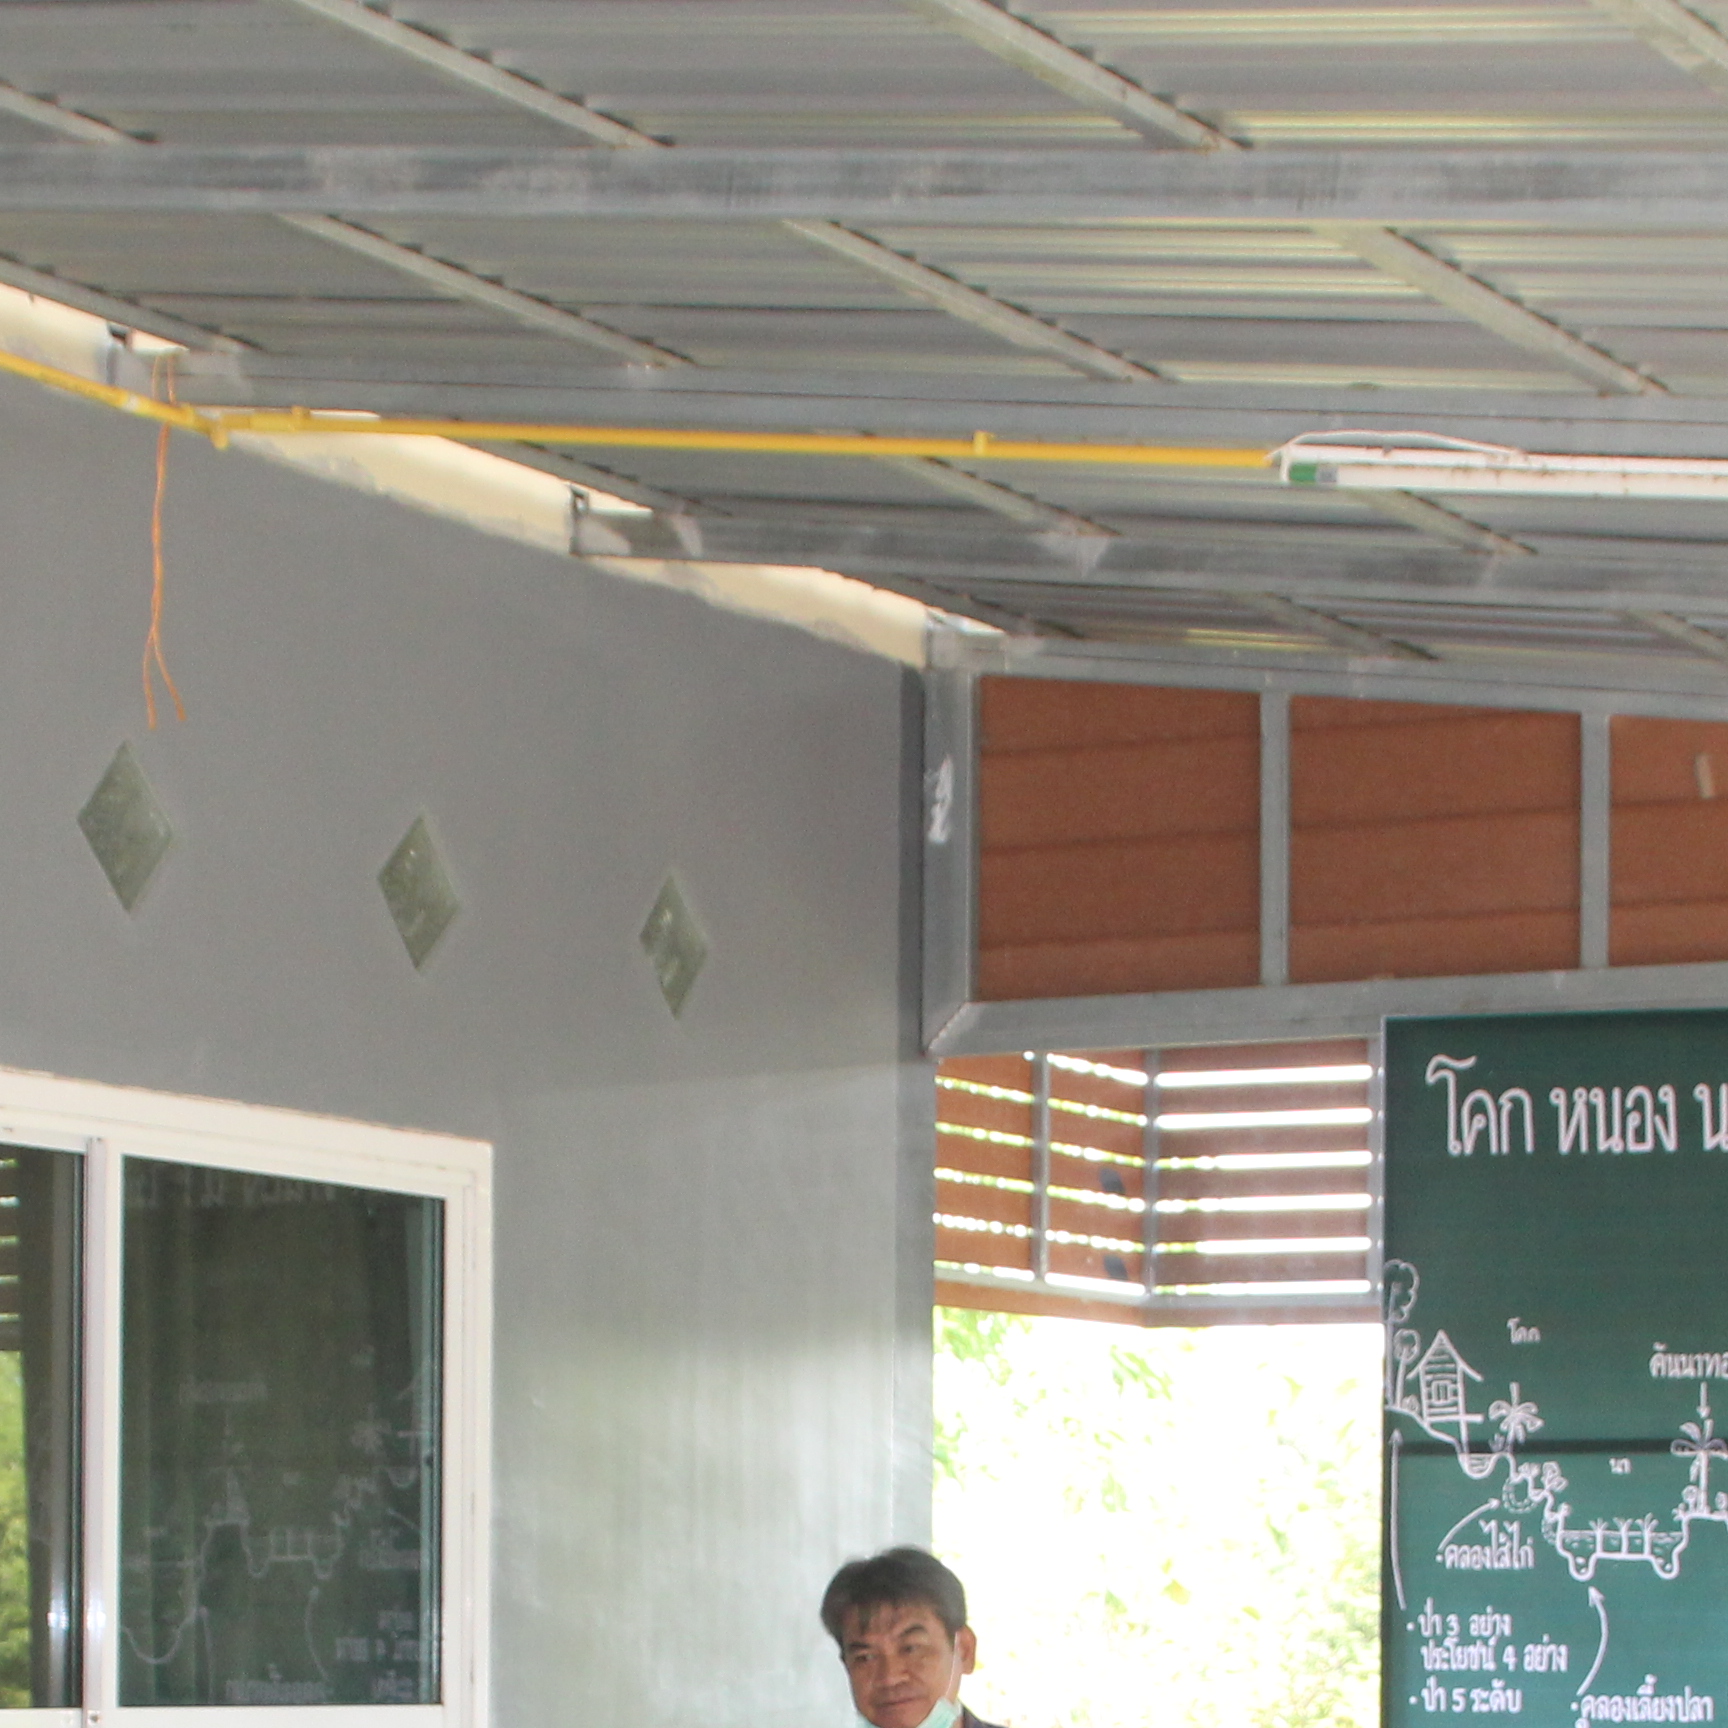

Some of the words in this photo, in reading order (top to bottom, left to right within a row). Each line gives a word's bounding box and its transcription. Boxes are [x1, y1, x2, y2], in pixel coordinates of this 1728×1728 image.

[1426, 1054, 1535, 1155] โคก
[1549, 1084, 1677, 1154] หนอง
[1506, 1317, 1541, 1344] โคก
[1609, 1457, 1631, 1474] นา
[1446, 1613, 1460, 1637] 3
[1502, 1644, 1518, 1672] 4
[1523, 1633, 1569, 1672] อย่าง
[1451, 1687, 1467, 1713] 5
[1470, 1678, 1523, 1713] ระดับ
